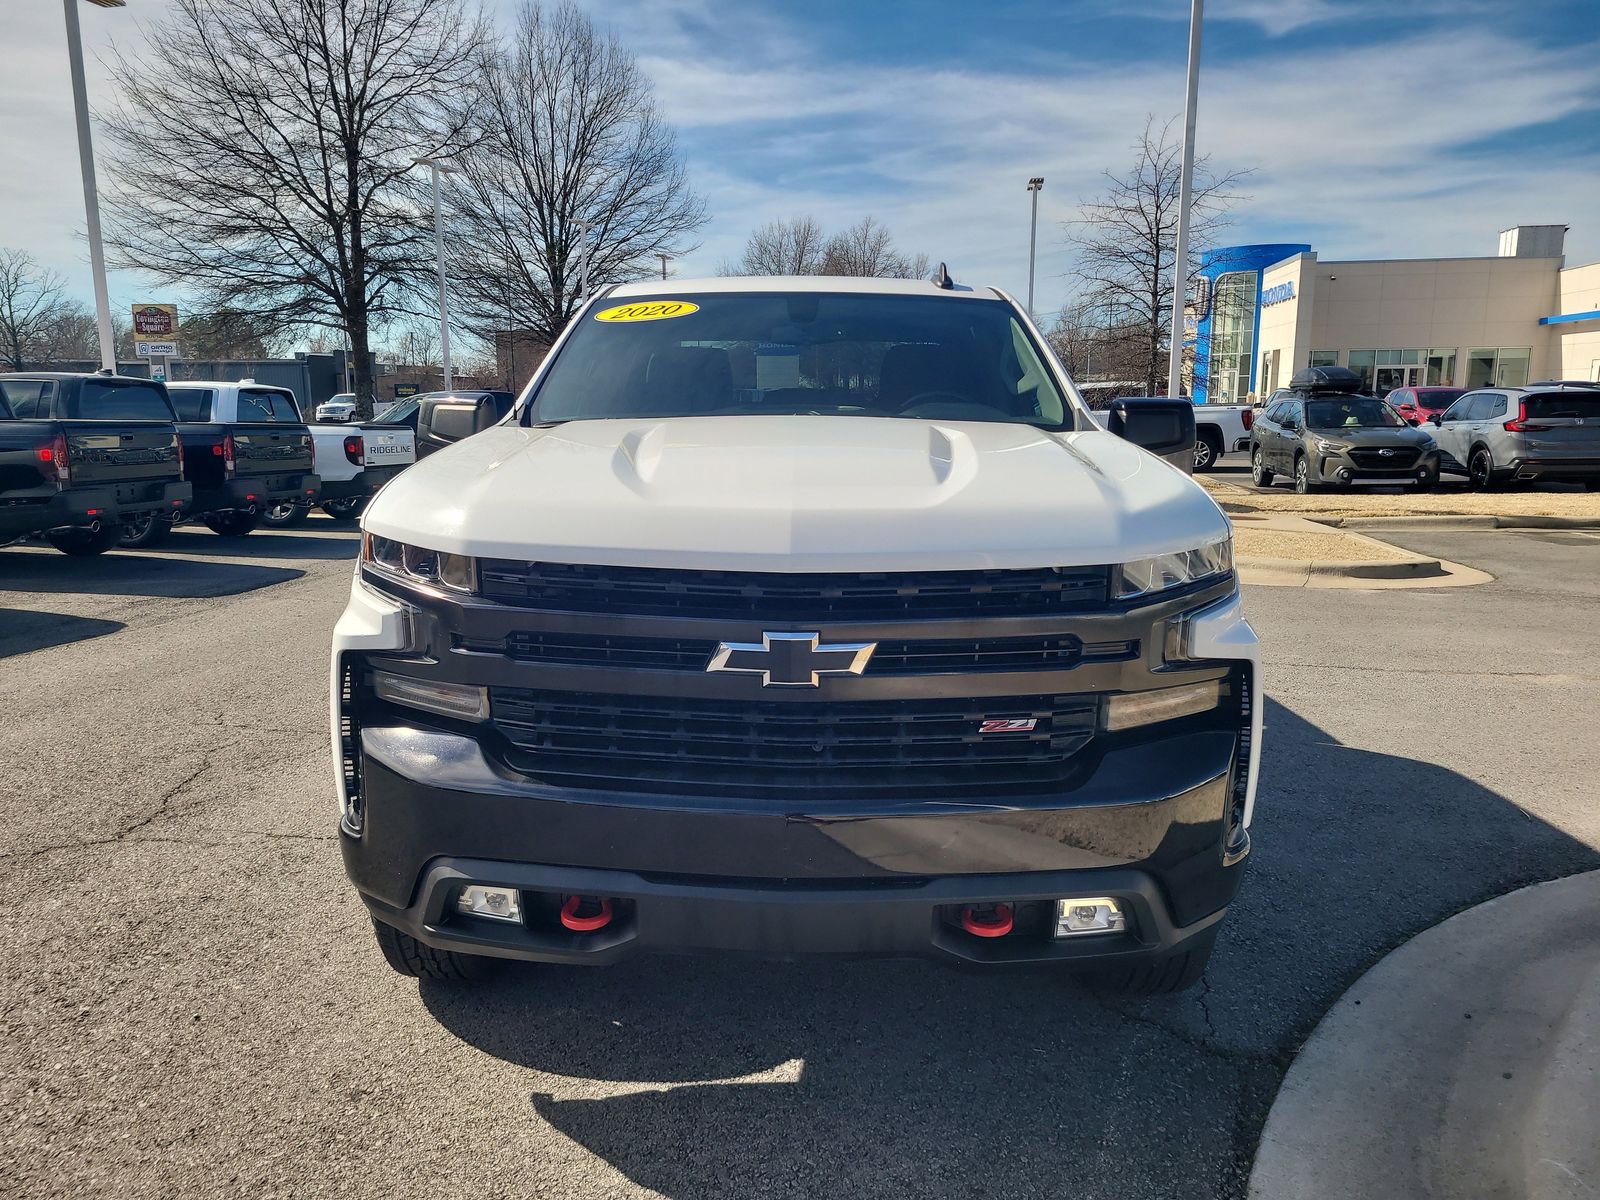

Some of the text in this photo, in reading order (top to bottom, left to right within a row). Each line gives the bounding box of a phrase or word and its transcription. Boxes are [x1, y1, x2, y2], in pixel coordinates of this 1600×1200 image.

[1261, 281, 1296, 304] HONDA
[609, 304, 683, 320] 2020
[141, 322, 165, 334] Square
[370, 445, 412, 454] RIDGELINE
